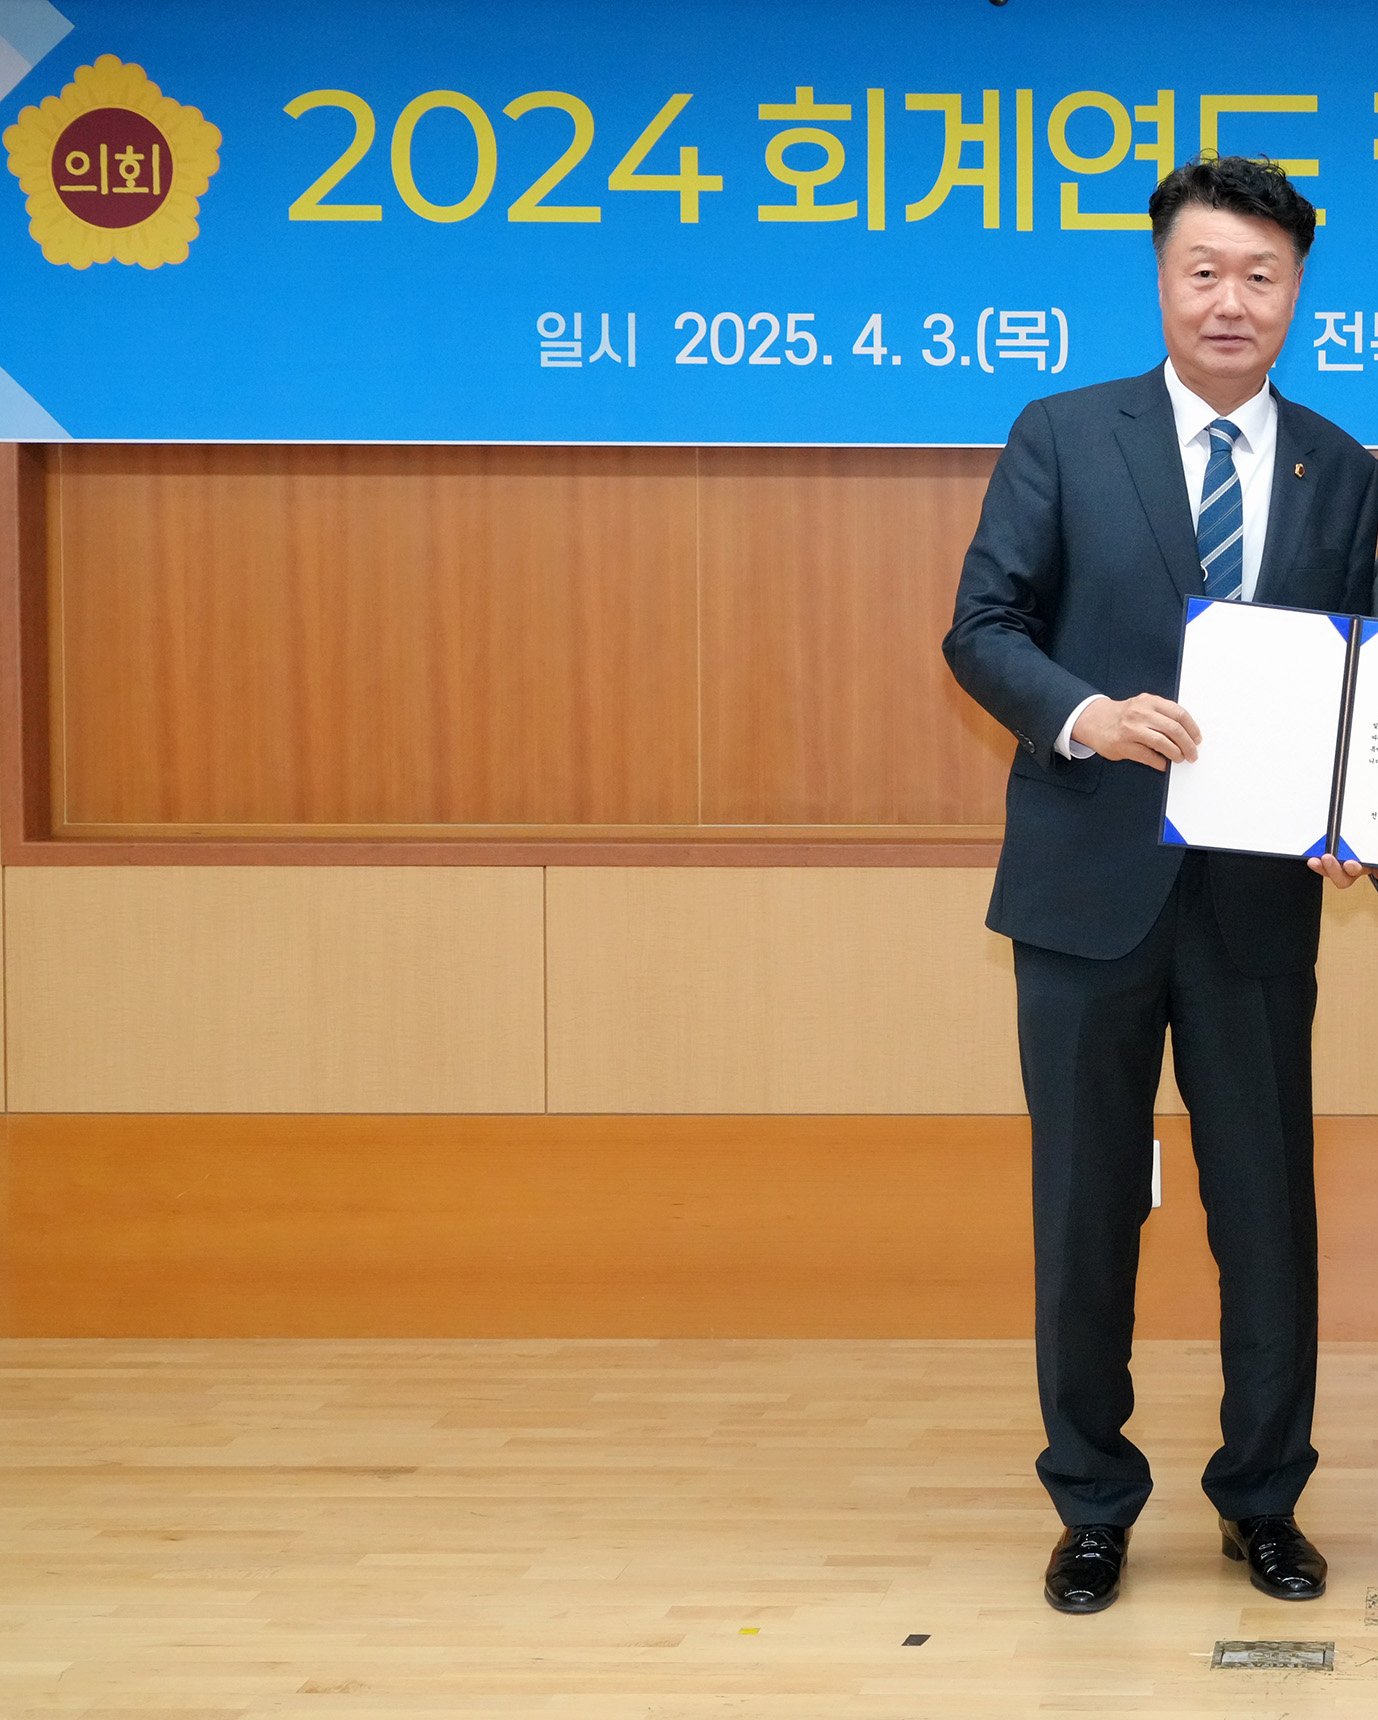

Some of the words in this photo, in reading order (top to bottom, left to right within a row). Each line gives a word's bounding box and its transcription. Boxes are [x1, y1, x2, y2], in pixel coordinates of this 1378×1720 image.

[59, 142, 162, 198] 의회
[283, 89, 724, 224] 2024
[535, 311, 638, 369] 일시
[673, 311, 834, 366] 2025.
[852, 313, 903, 366] 4.
[921, 307, 1070, 374] 3.(목)
